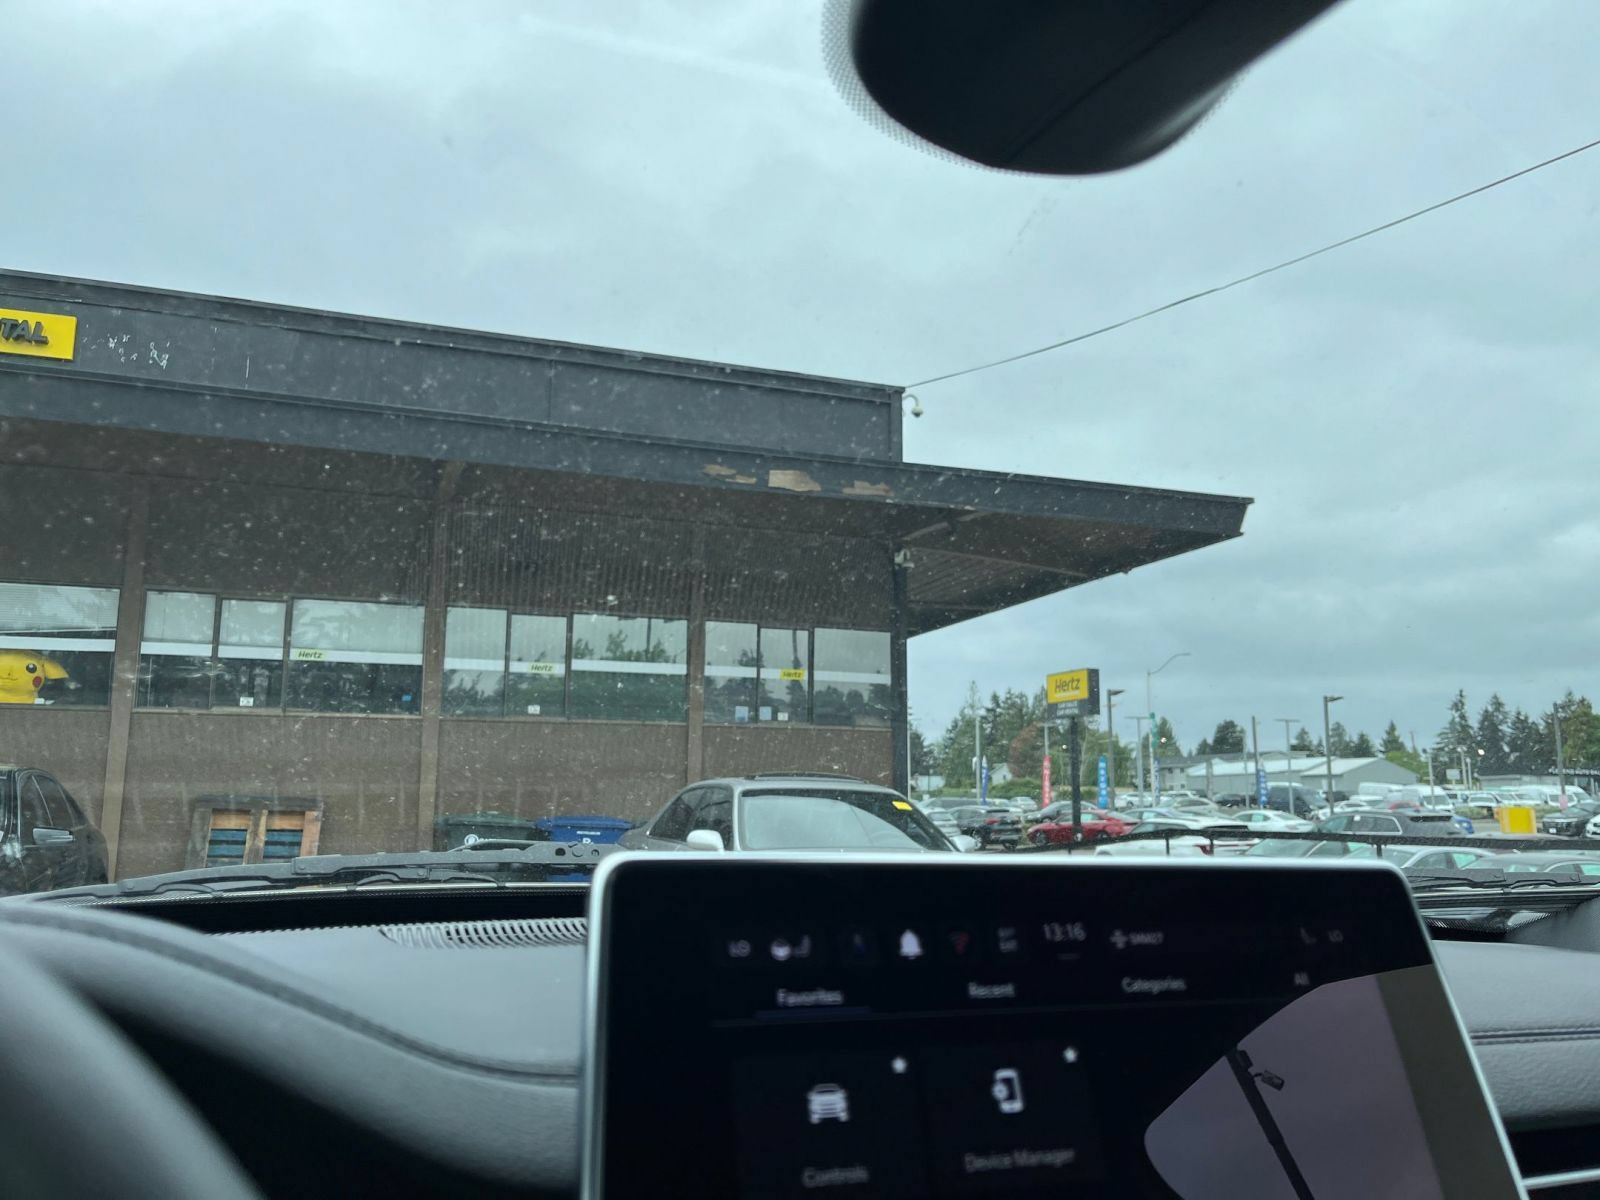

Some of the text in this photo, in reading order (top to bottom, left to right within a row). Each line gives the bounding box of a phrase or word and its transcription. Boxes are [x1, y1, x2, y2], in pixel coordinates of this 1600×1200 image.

[297, 650, 323, 660] Hertz
[530, 663, 554, 673] Hertz
[782, 670, 803, 679] Hertz
[1054, 676, 1081, 694] Hertz
[1043, 922, 1087, 942] 13:16
[967, 982, 1015, 999] Recent
[1121, 976, 1187, 996] Categories
[776, 988, 844, 1007] Favorites
[964, 1148, 1076, 1173] Device Manager
[801, 1166, 870, 1188] Controls
